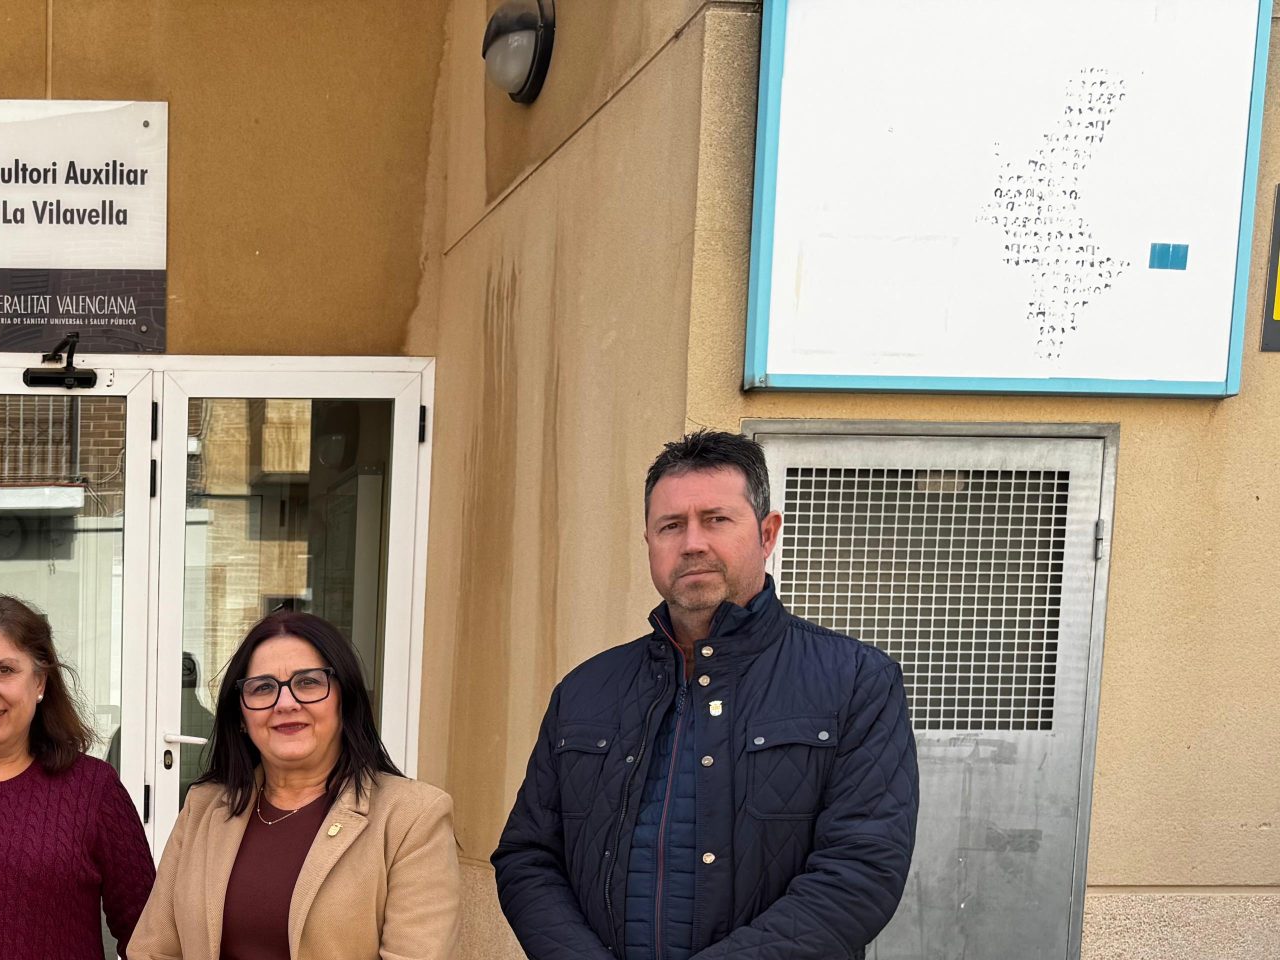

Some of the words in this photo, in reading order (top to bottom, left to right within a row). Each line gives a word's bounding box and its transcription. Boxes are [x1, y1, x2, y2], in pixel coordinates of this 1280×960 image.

[64, 160, 148, 185] Auxiliar
[2, 200, 25, 224] La
[32, 199, 128, 225] Vilavella
[56, 295, 137, 315] VALENCIANA
[23, 317, 48, 325] SANITAT
[50, 317, 83, 325] UNIVERSAL
[110, 317, 137, 325] PÚBLICA
